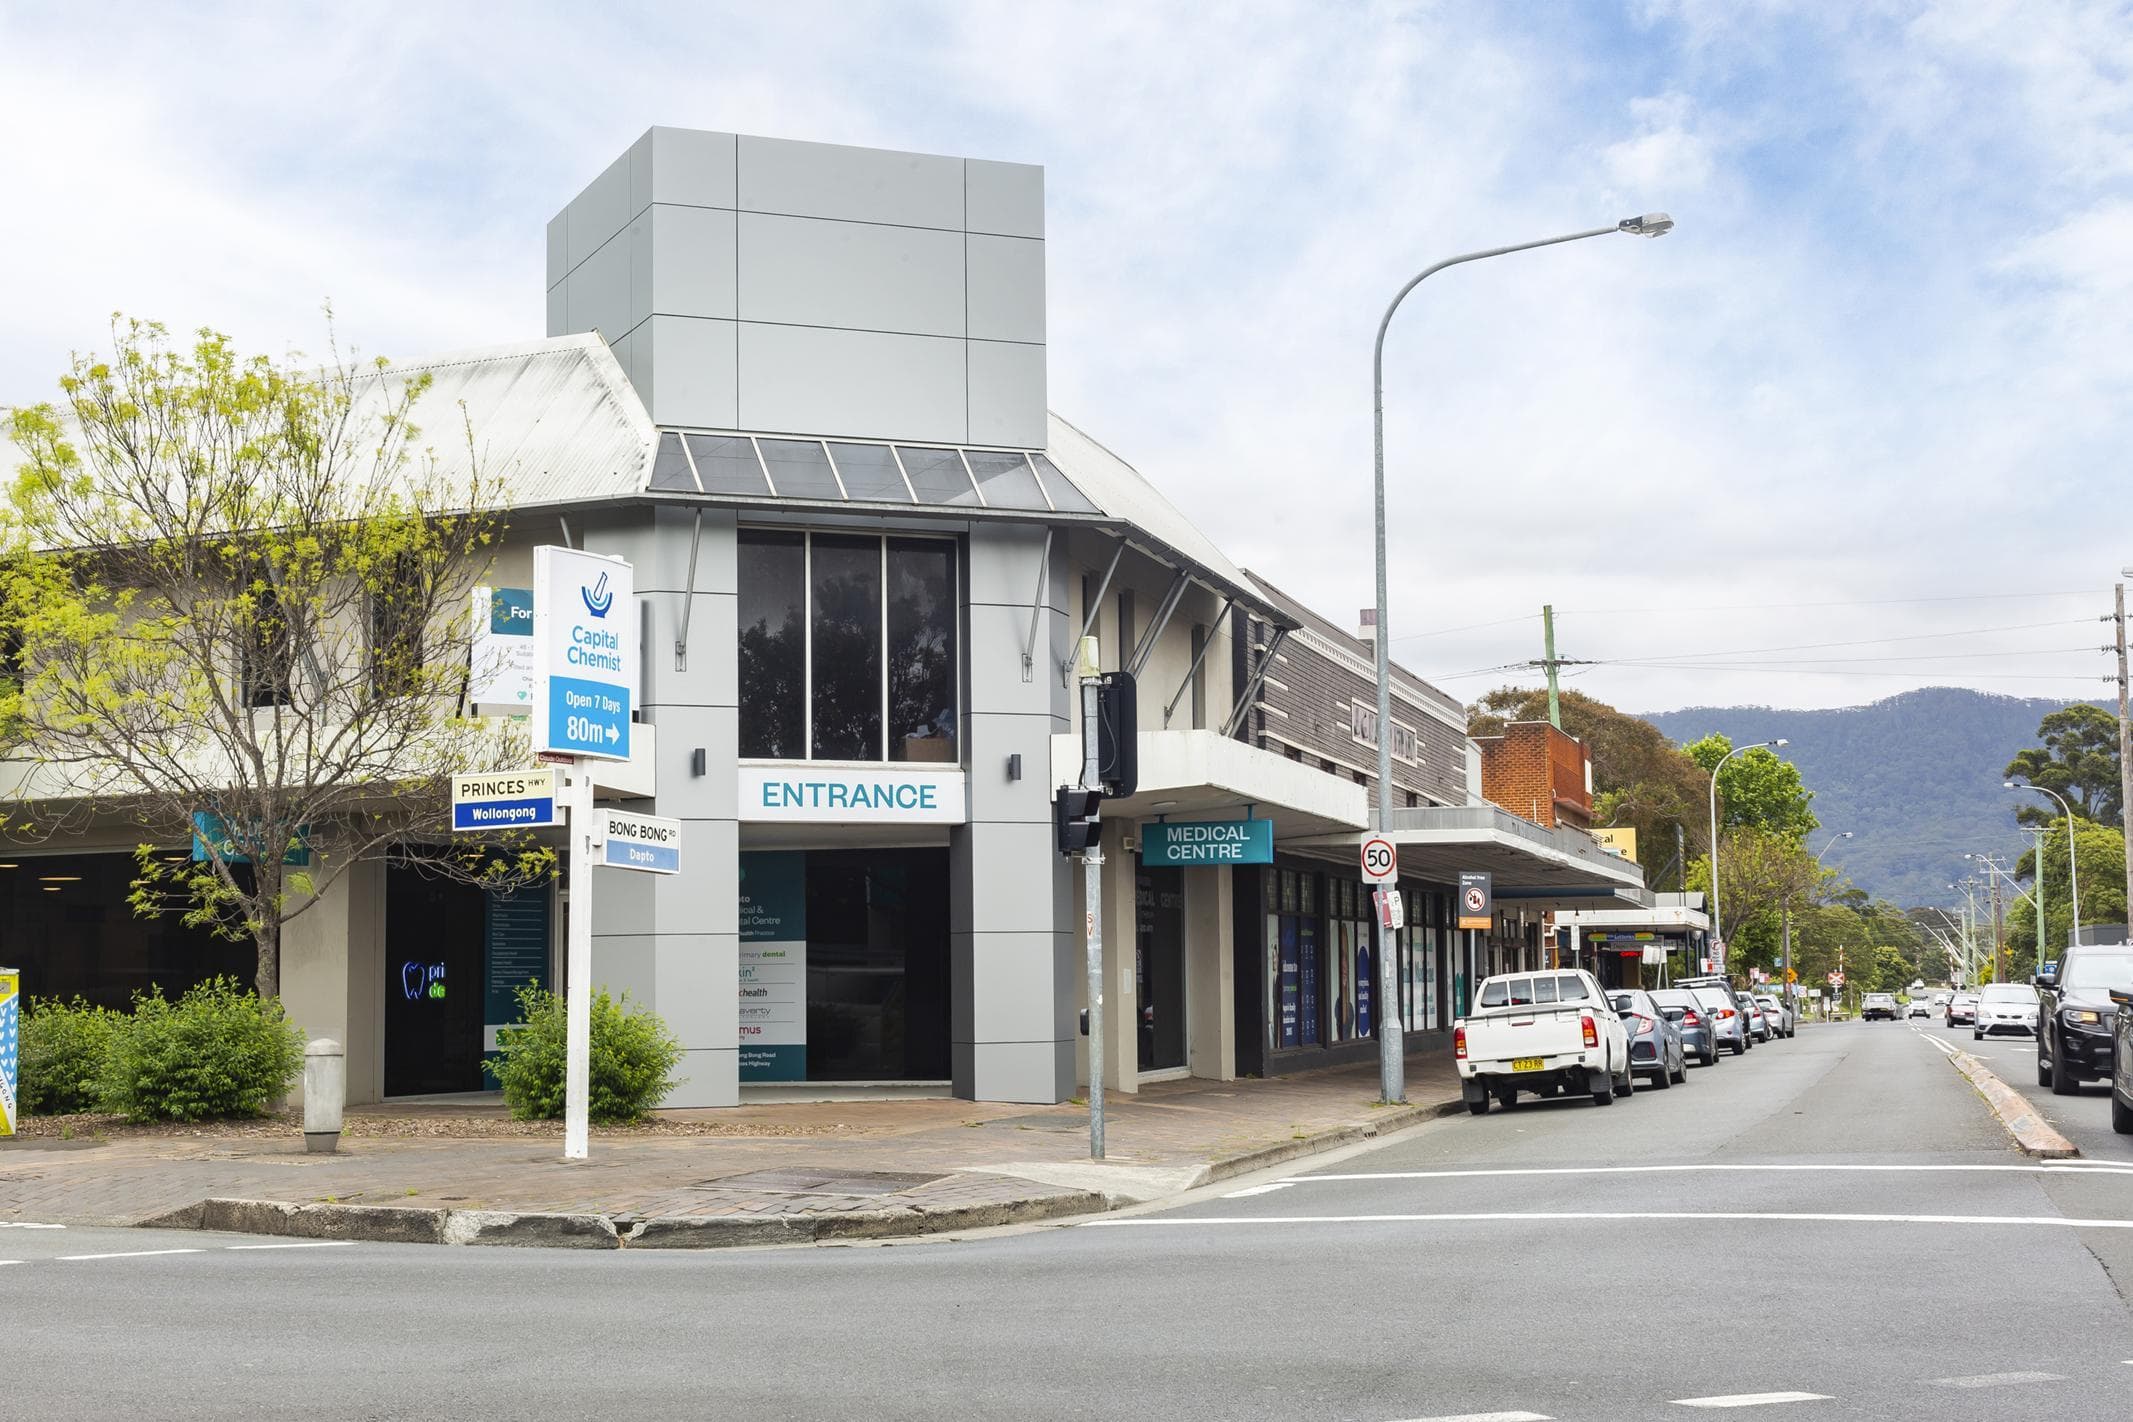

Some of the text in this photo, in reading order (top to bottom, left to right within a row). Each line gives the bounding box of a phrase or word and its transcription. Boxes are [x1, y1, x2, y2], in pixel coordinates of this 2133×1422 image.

[572, 625, 619, 651] Capital
[567, 646, 621, 673] Chemist
[566, 690, 621, 713] Open 7 Days
[566, 716, 603, 744] 80m
[461, 778, 546, 798] PRINCES HWY
[762, 782, 938, 809] ENTRANCE
[472, 805, 536, 821] Wollongong
[609, 821, 677, 842] BONG BONG RD
[1167, 826, 1250, 842] MEDICAL
[629, 849, 655, 864] Dapto
[1167, 844, 1243, 860] CENTRE
[1367, 849, 1391, 867] 50
[752, 916, 781, 925] Centre
[762, 950, 786, 958] dental
